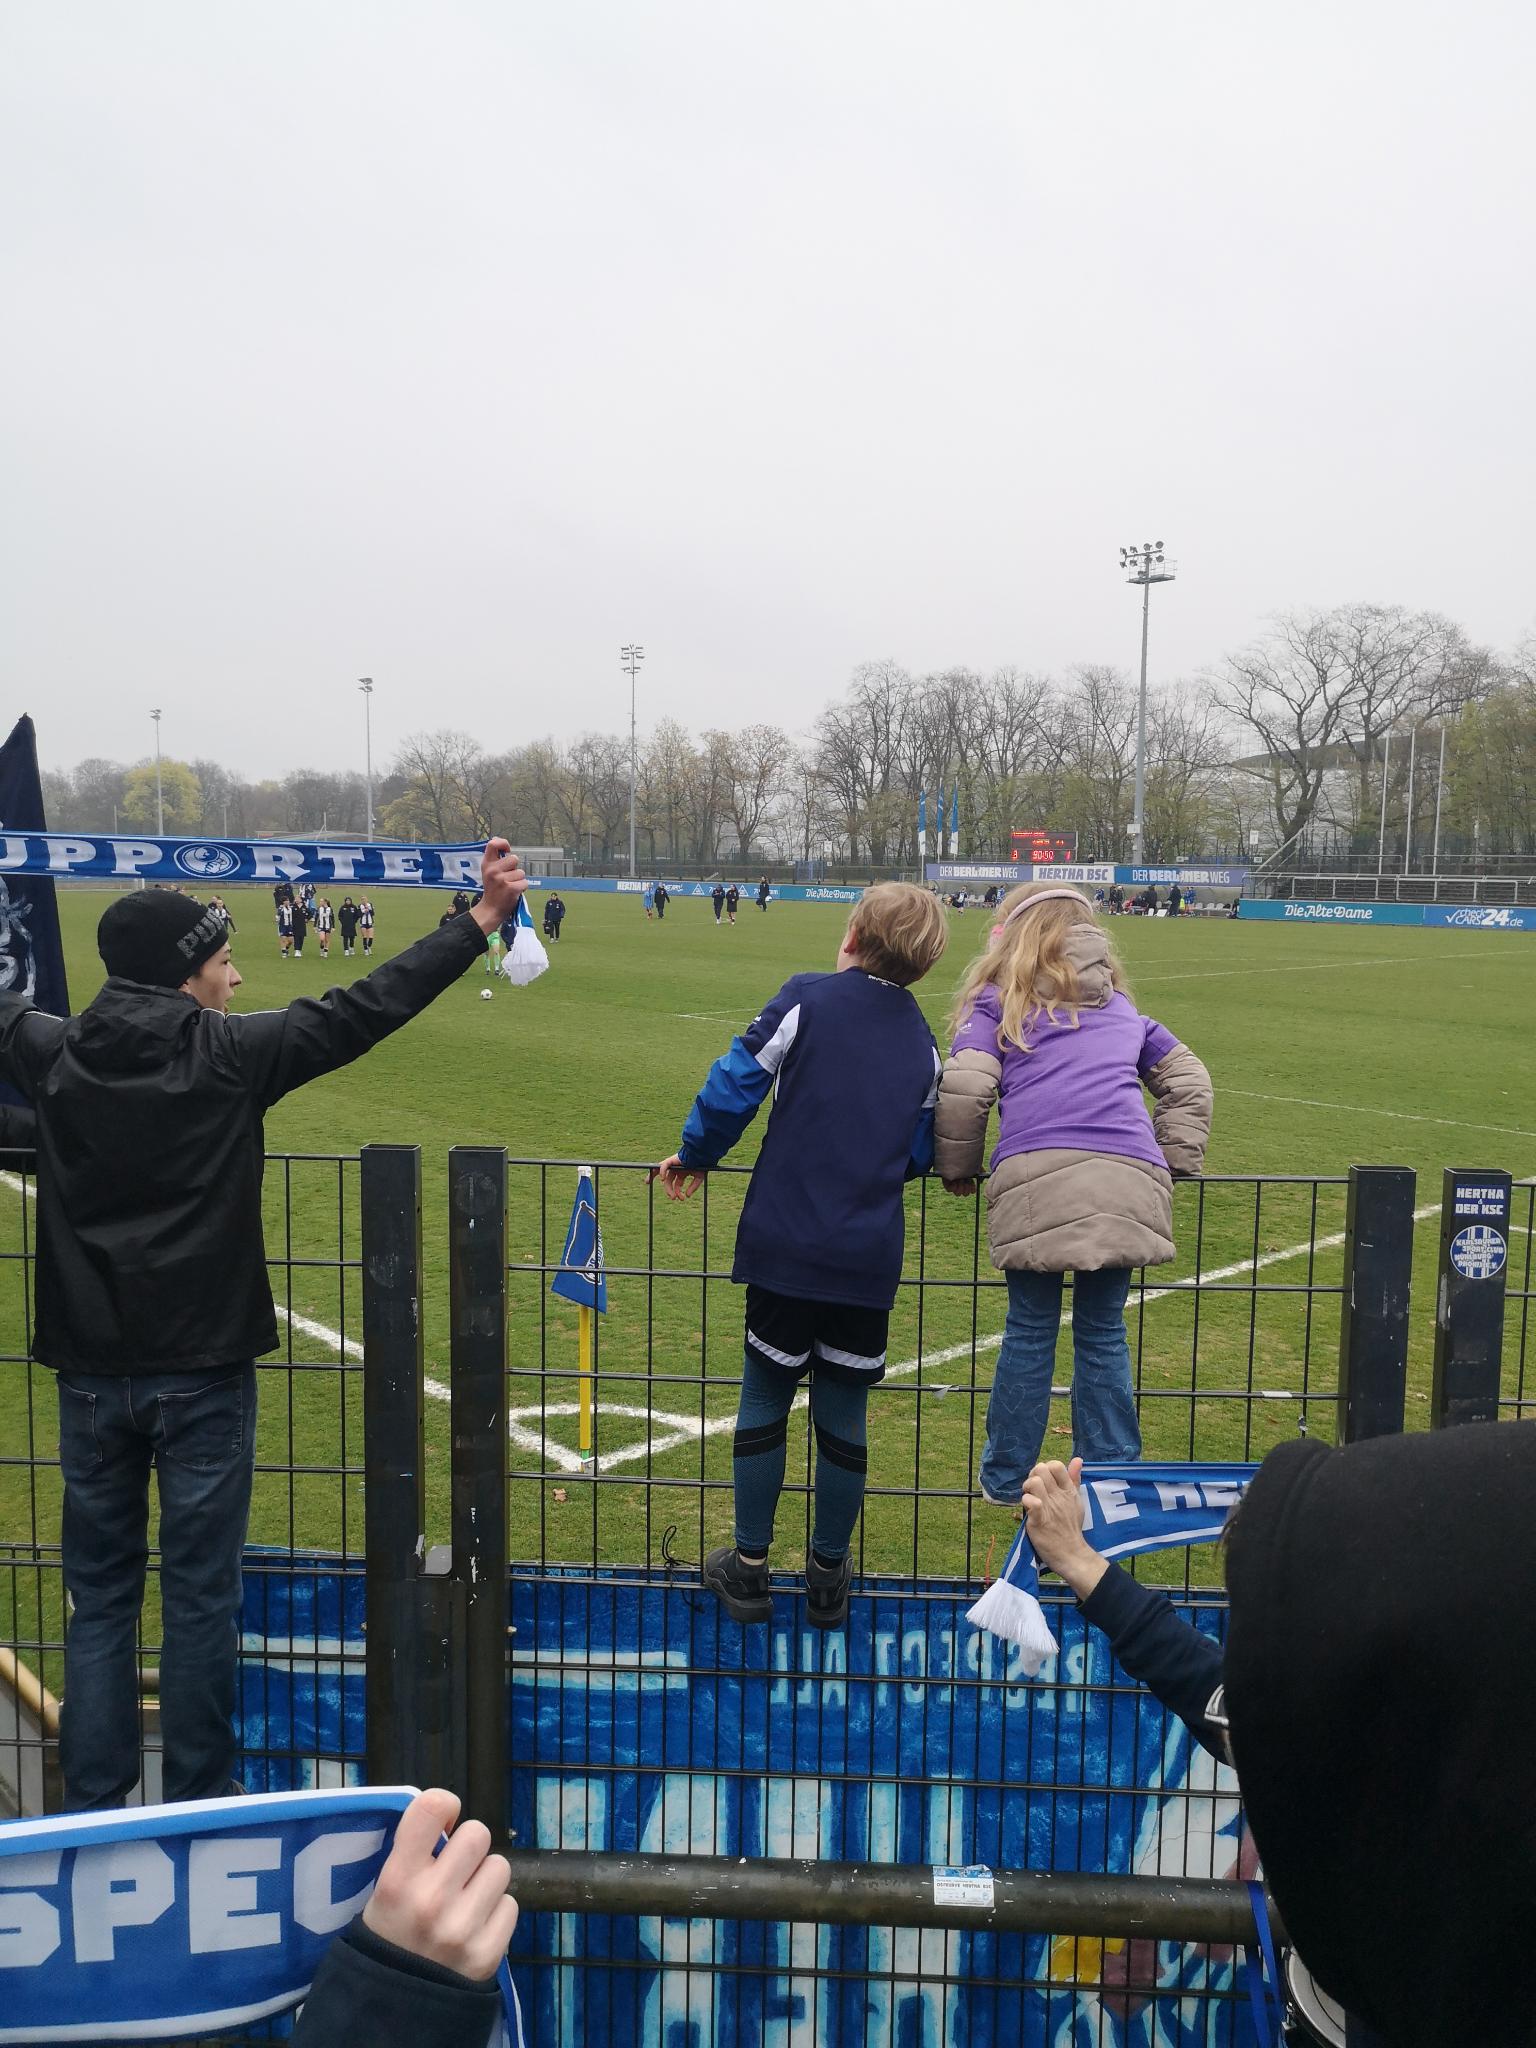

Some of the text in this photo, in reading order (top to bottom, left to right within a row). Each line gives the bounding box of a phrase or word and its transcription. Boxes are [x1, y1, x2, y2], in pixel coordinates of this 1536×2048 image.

[940, 866, 953, 877] DER
[1002, 867, 1018, 879] WEG
[1038, 867, 1109, 881] HERTHA BSC
[1132, 869, 1149, 881] DER
[1210, 871, 1230, 884] WEG
[1284, 904, 1373, 919] Die Alte Dame
[1456, 1188, 1504, 1199] HERTHA
[1455, 1203, 1503, 1215] DER KSC
